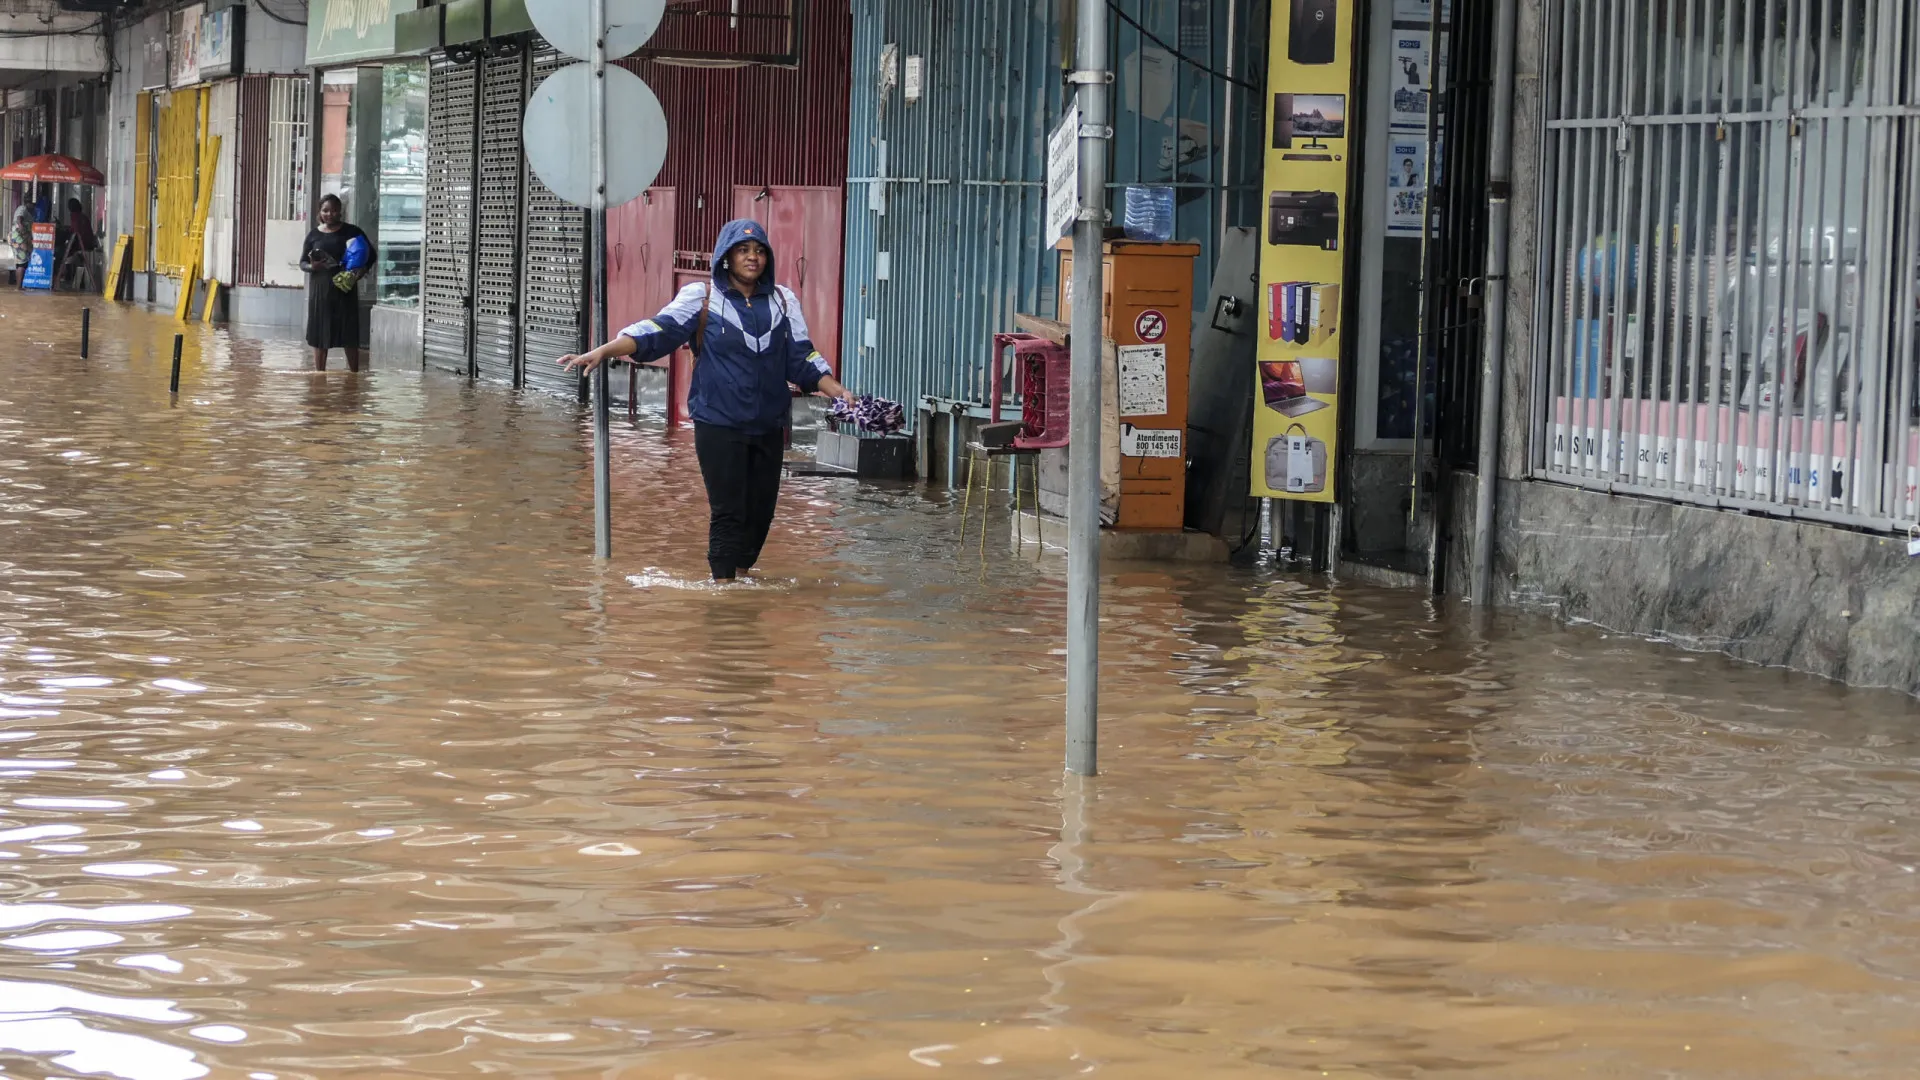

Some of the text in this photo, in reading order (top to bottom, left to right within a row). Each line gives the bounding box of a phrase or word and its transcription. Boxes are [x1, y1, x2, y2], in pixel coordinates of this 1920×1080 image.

[1136, 434, 1179, 442] Atendimento
[1136, 442, 1179, 450] 800 145 145
